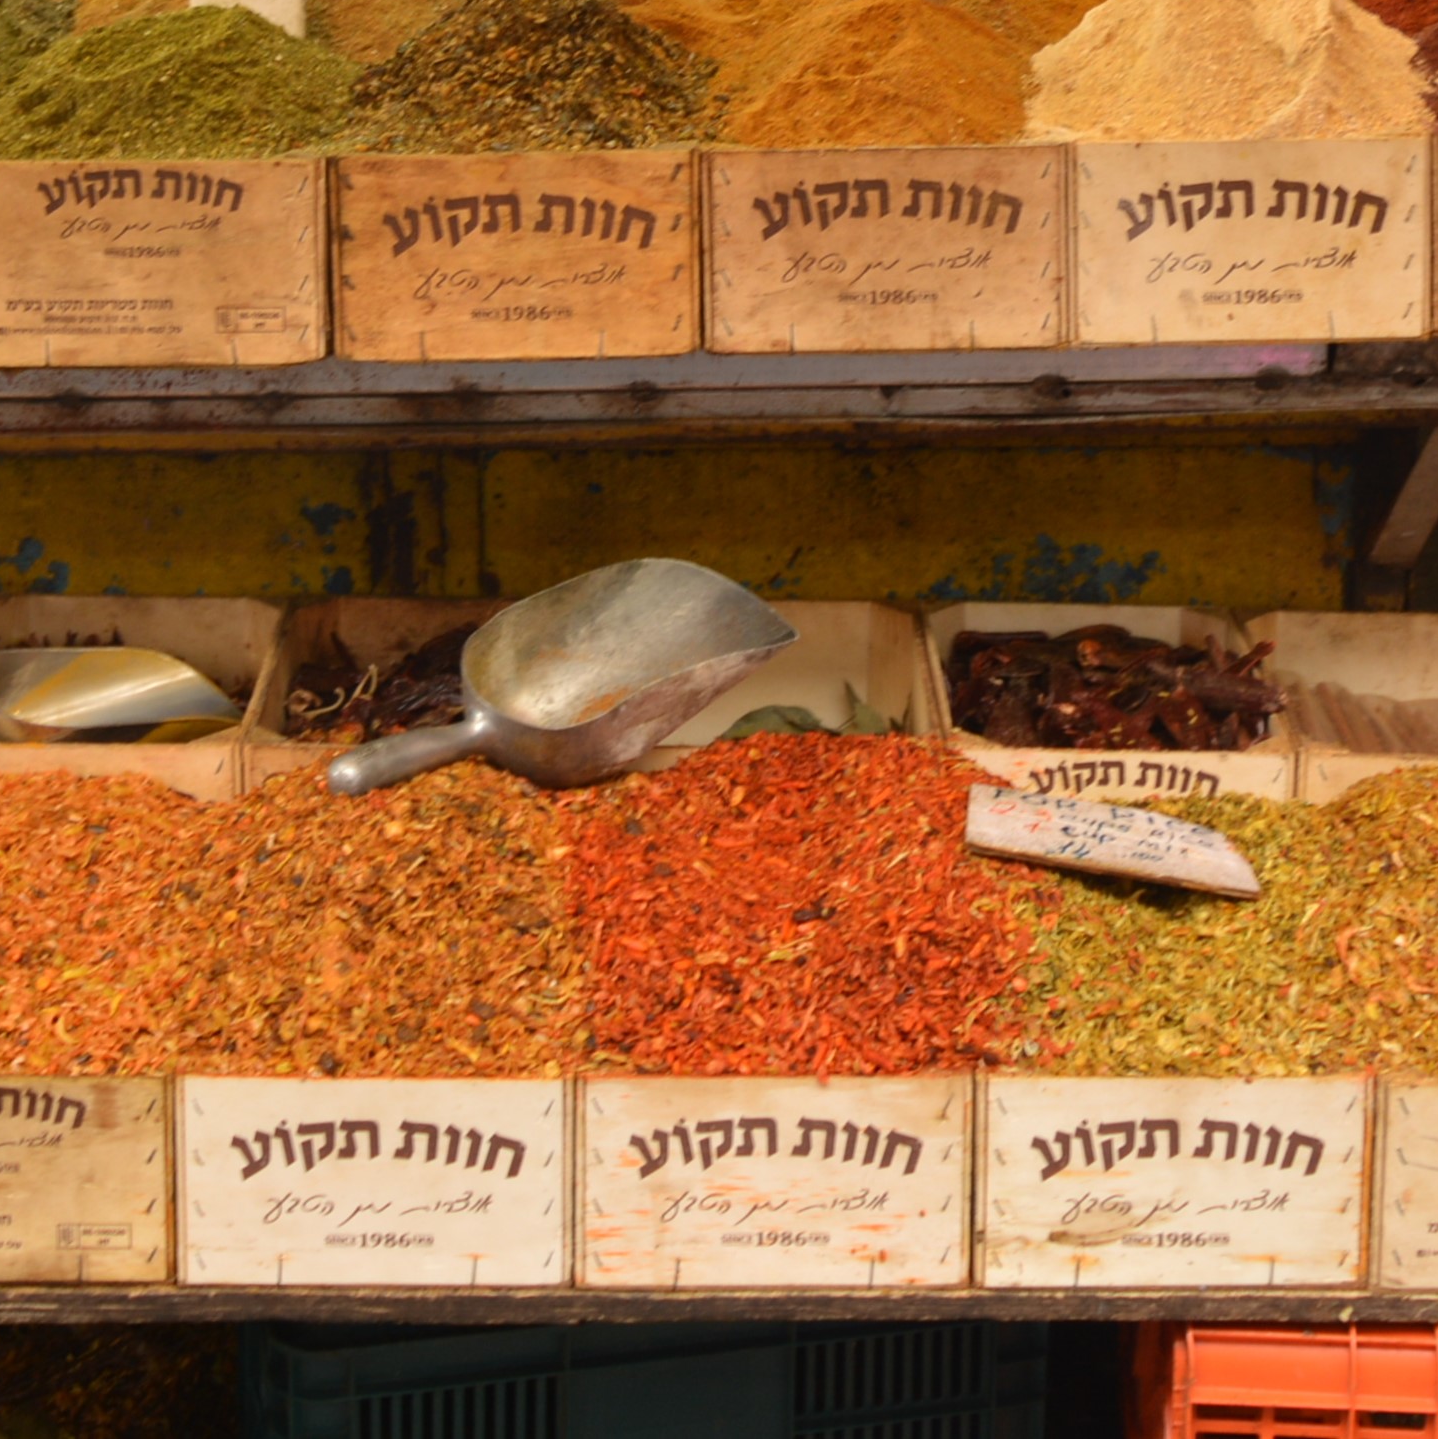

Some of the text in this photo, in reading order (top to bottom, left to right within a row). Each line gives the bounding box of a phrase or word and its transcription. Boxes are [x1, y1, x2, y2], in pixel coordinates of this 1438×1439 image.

[152, 168, 244, 212] חוות
[901, 178, 1023, 235] חוות
[1267, 179, 1389, 235] חוות
[533, 193, 657, 250] חוות
[501, 305, 551, 322] 1986
[869, 289, 918, 306] 1986
[1233, 289, 1283, 305] 1986
[1134, 760, 1221, 798] חוות
[393, 1120, 527, 1179] חוות
[791, 1116, 925, 1176] חוות
[1192, 1117, 1326, 1177] חוות
[359, 1233, 412, 1249] 1986
[755, 1230, 807, 1247] 1986
[1155, 1231, 1207, 1249] 1986
